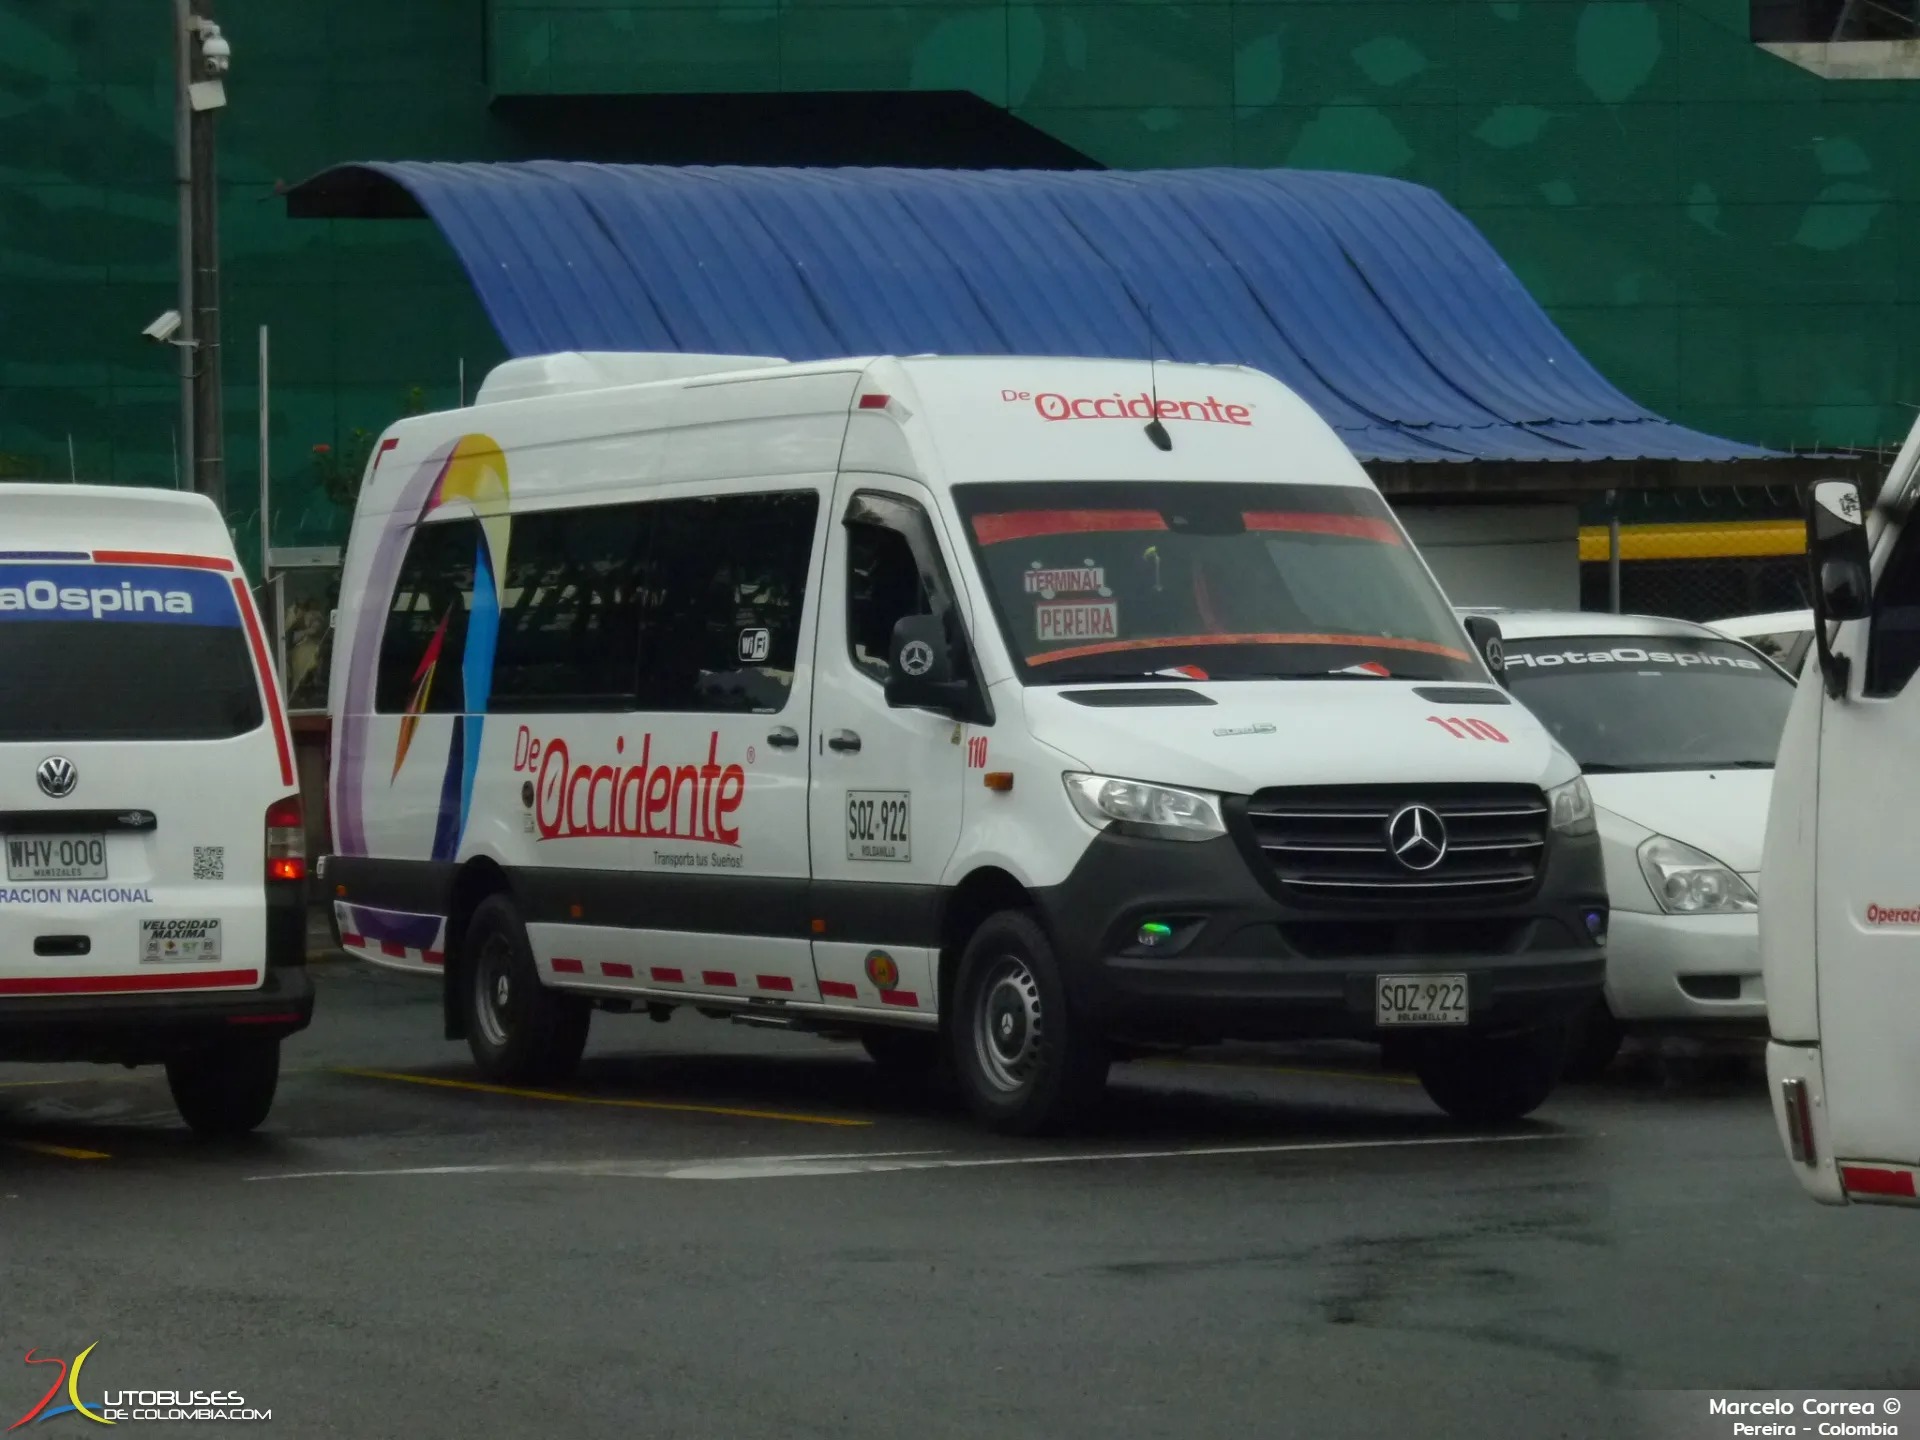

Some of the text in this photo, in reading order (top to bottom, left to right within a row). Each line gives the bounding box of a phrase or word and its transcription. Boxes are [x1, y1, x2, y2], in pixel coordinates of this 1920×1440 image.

[1001, 389, 1253, 425] De Occidente
[1025, 570, 1102, 592] TERMINAL
[0, 580, 193, 618] aOspina
[1040, 608, 1115, 637] PEREIRA
[1504, 648, 1762, 670] FlotaOspina
[1426, 715, 1510, 743] 110
[967, 736, 988, 768] 110
[514, 725, 744, 846] De Occidente
[653, 851, 695, 868] Transporta
[696, 852, 709, 867] tus
[0, 888, 154, 903] RACION NACIONAL
[143, 920, 218, 930] VELOCIDAD
[151, 929, 206, 939] MAXIMA
